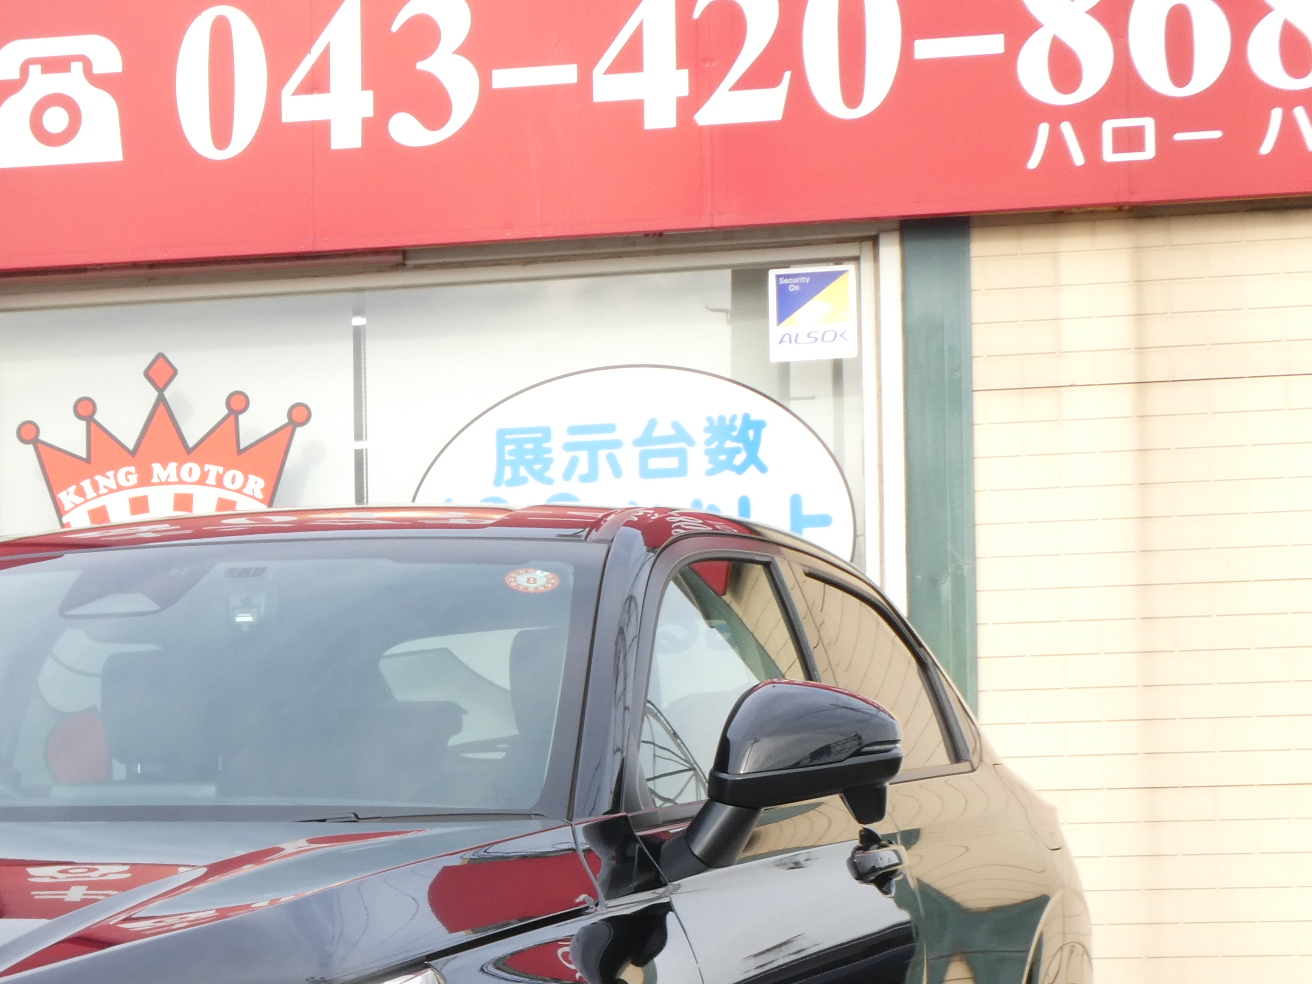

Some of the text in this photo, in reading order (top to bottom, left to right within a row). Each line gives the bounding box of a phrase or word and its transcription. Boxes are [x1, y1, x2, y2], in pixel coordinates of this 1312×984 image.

[1026, 115, 1223, 170] ハロー
[779, 276, 810, 285] Security
[777, 329, 849, 346] ALSOK
[492, 411, 769, 488] 展示台数
[55, 462, 266, 512] KING MOTOR
